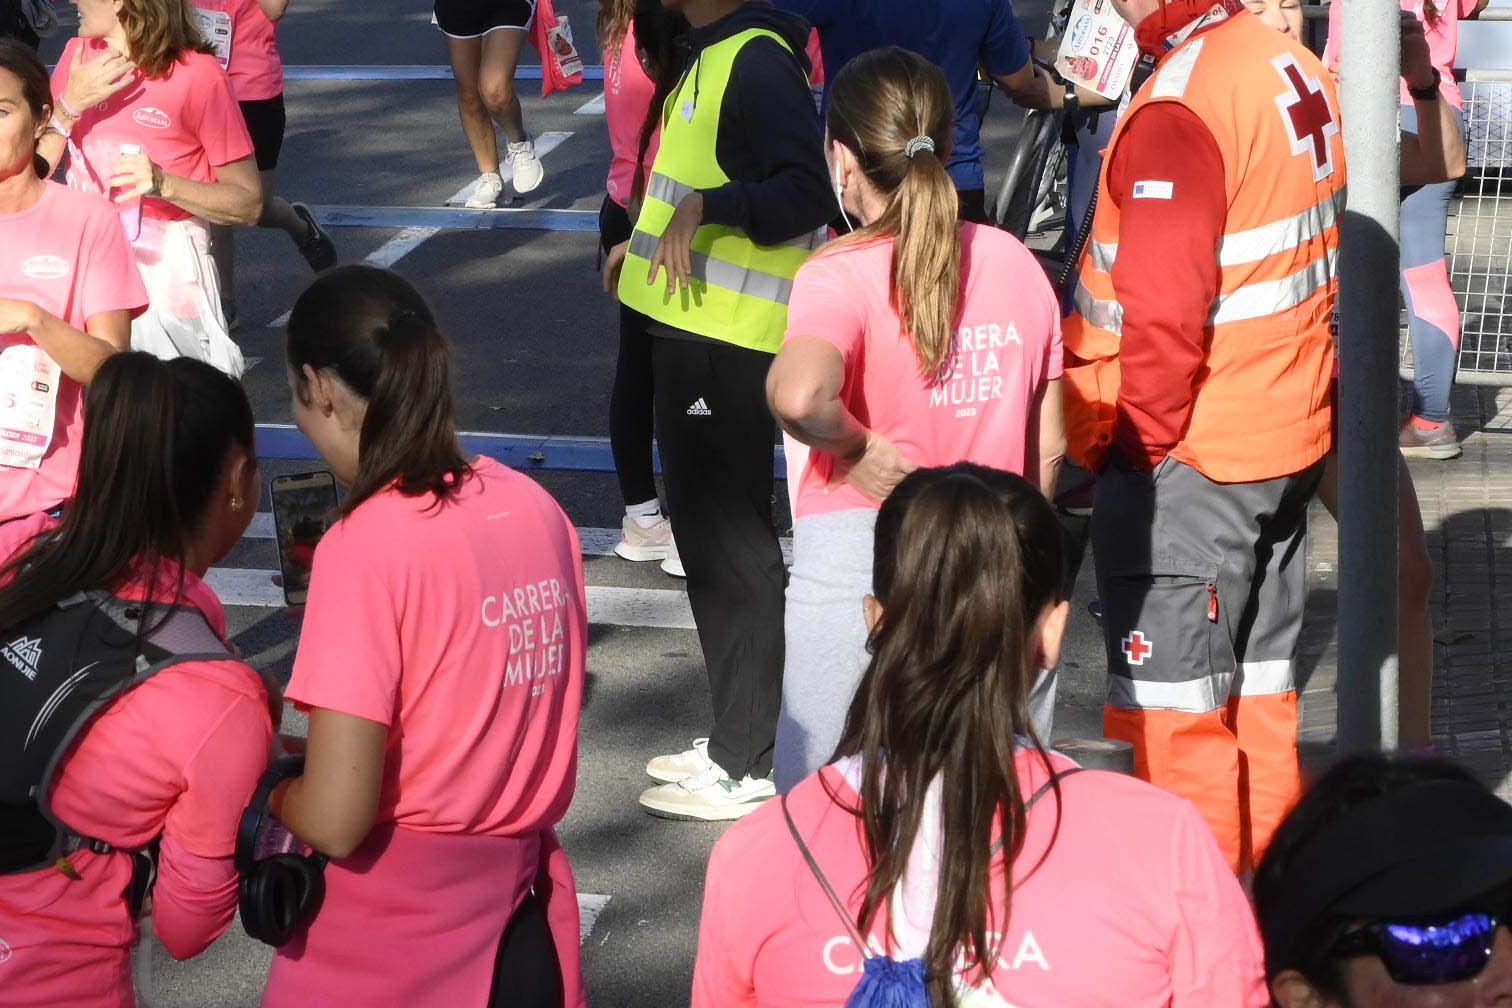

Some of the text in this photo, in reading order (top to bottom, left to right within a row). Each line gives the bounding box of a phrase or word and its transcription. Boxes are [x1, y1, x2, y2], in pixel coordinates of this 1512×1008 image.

[1089, 25, 1109, 56] 016
[971, 351, 1001, 377] LA
[929, 375, 1004, 409] MUJER
[686, 405, 713, 417] adidas
[508, 611, 565, 655] DE LA
[0, 645, 37, 681] AONIJIE
